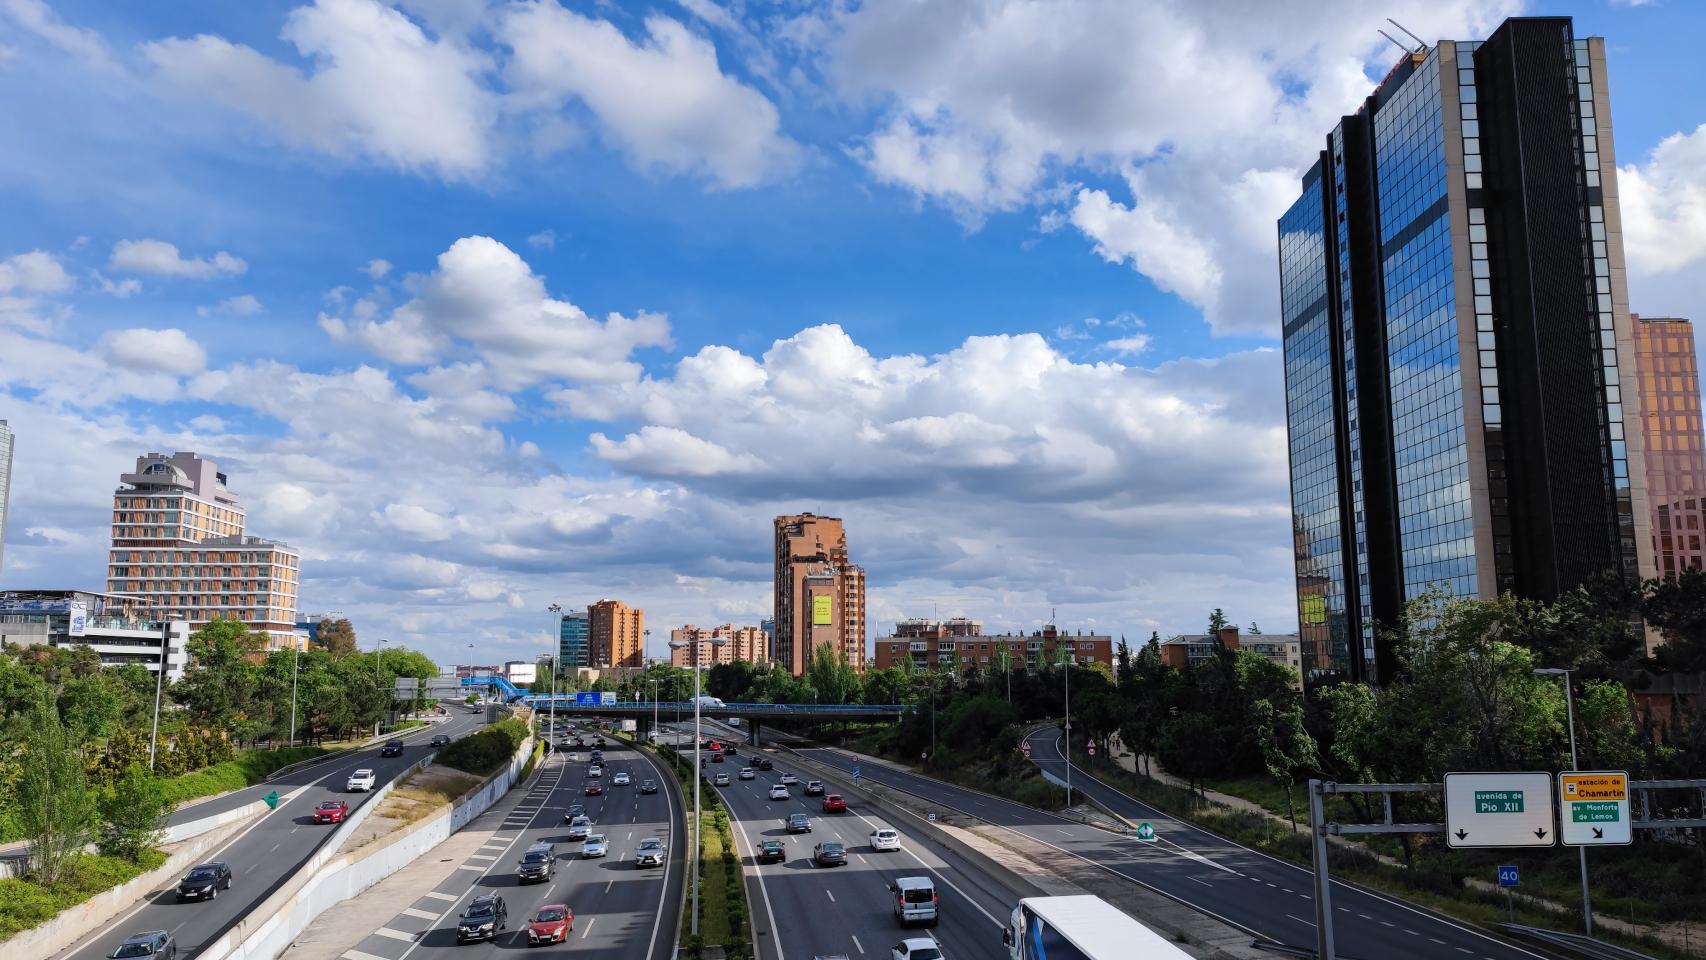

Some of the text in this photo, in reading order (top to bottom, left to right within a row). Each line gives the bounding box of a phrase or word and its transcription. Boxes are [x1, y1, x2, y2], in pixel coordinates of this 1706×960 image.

[1476, 792, 1522, 800] avenida de
[1504, 802, 1519, 812] XII
[1500, 871, 1518, 881] 40
